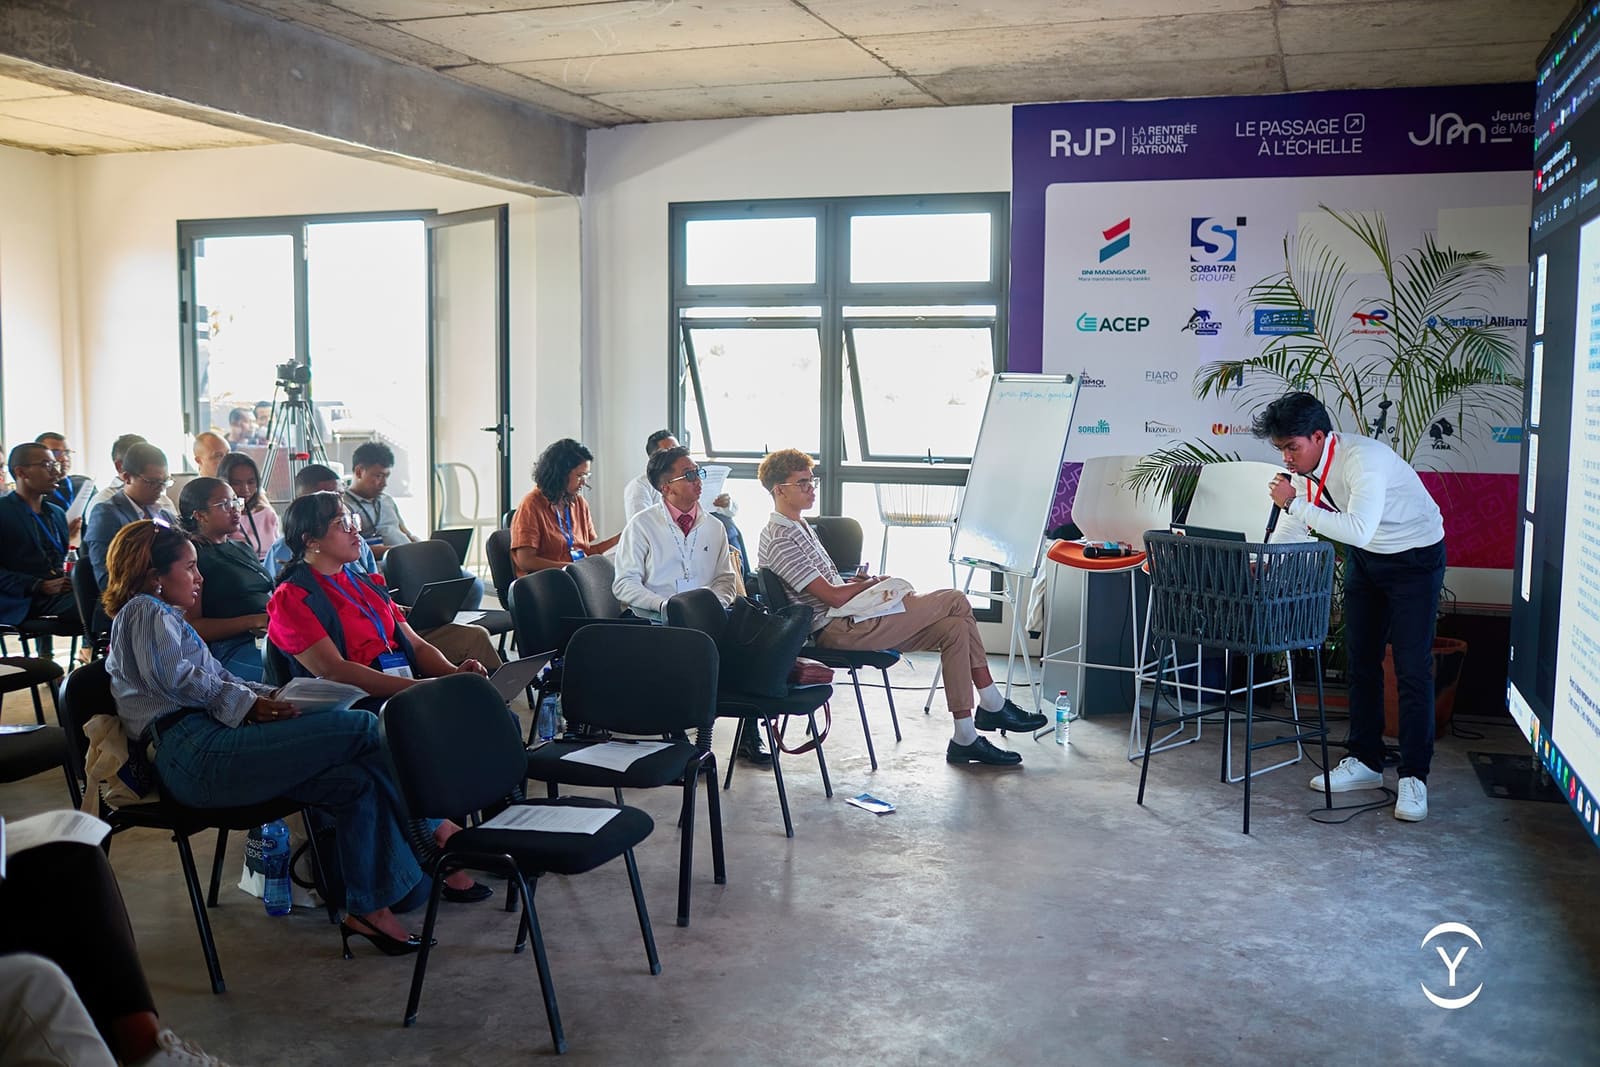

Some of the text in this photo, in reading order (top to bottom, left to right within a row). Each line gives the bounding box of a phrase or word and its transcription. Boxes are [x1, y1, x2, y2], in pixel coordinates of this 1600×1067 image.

[1491, 111, 1531, 121] Jeune
[1132, 122, 1197, 135] LA RENTRÉE
[1236, 118, 1339, 136] LE PASSAGE
[1491, 124, 1506, 135] de
[1050, 127, 1116, 157] RJP
[1132, 135, 1184, 145] DU JEUNE
[1132, 144, 1188, 155] PATRONAT
[1258, 136, 1271, 156] À
[1190, 265, 1236, 273] SOBATRA
[1099, 317, 1150, 332] ACEP
[1490, 315, 1528, 327] Allianz
[1145, 371, 1178, 380] FIARO
